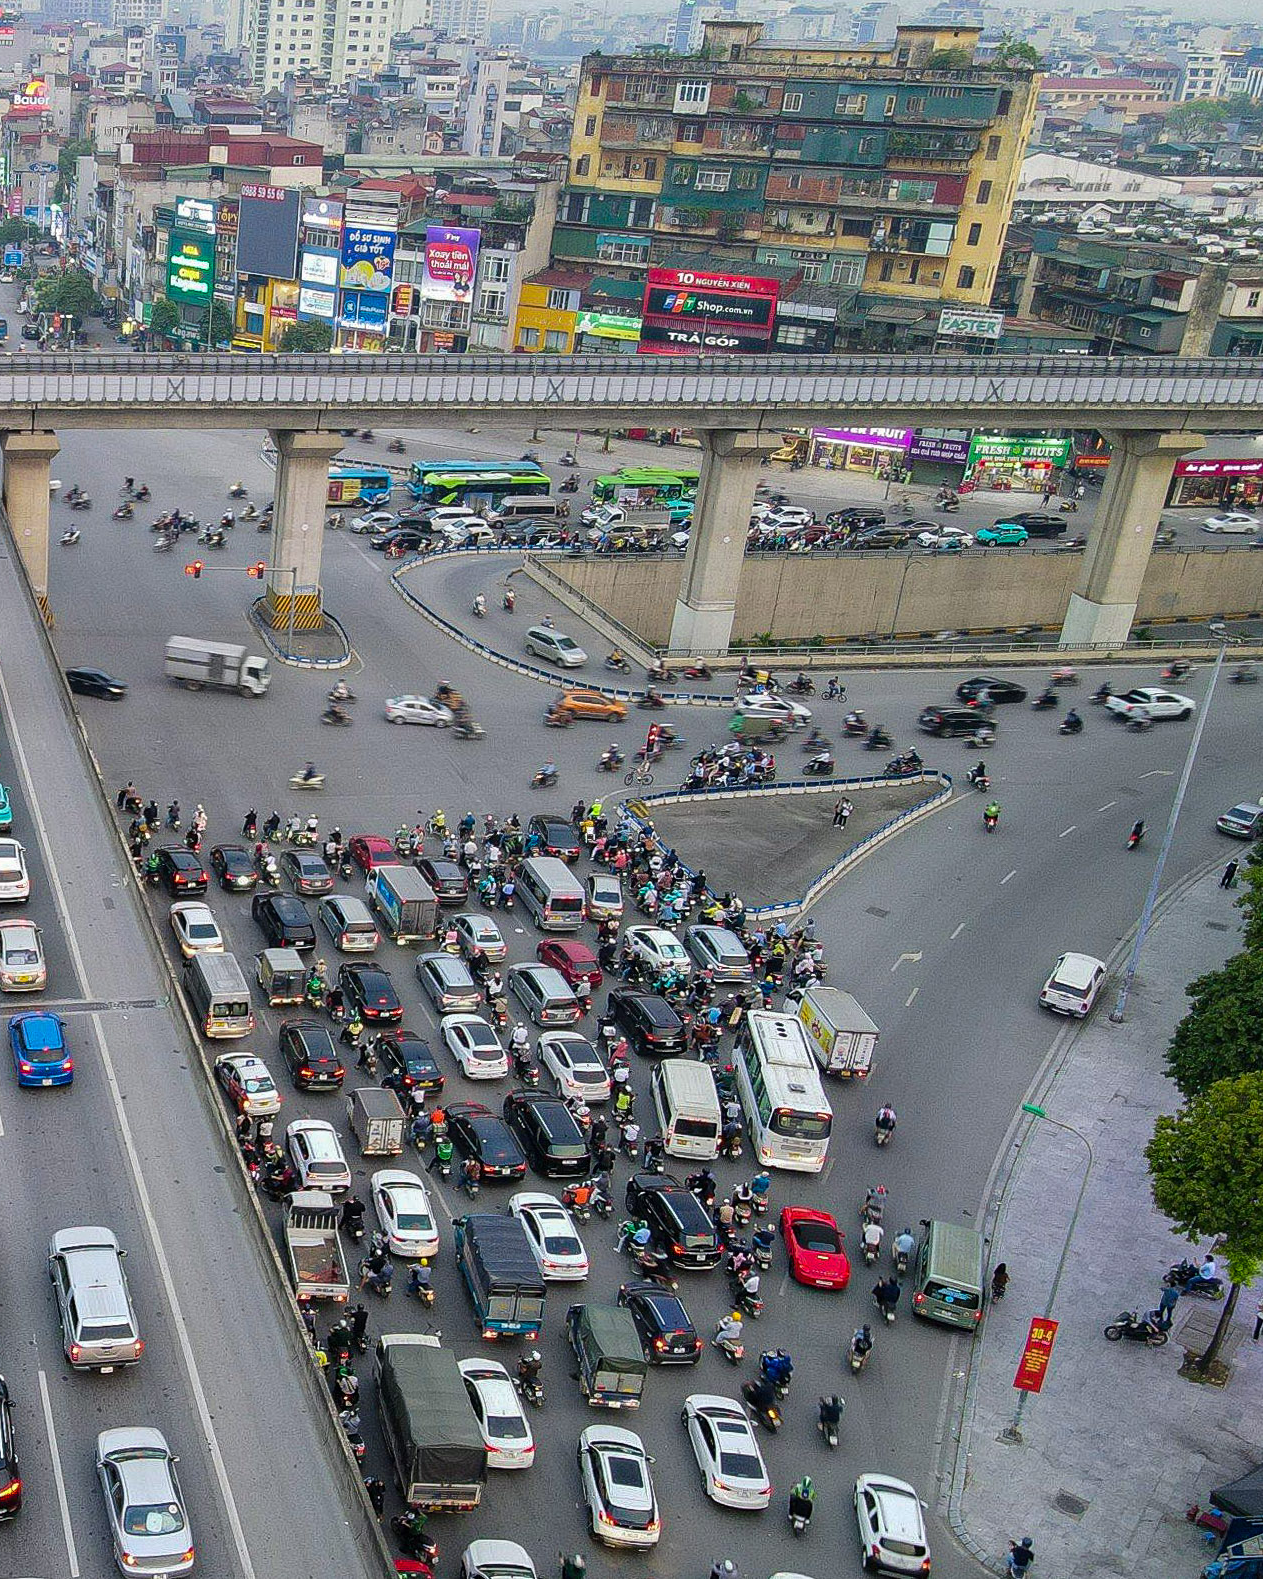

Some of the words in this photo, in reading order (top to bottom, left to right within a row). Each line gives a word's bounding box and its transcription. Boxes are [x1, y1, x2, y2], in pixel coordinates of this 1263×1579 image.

[677, 273, 694, 284] 10
[697, 301, 753, 315] Shop.com.vn
[942, 318, 996, 333] FASTER
[667, 331, 701, 343] TRẢ
[705, 335, 739, 347] GÓP
[974, 444, 1010, 454] FRESH
[1022, 446, 1064, 457] FRUITS
